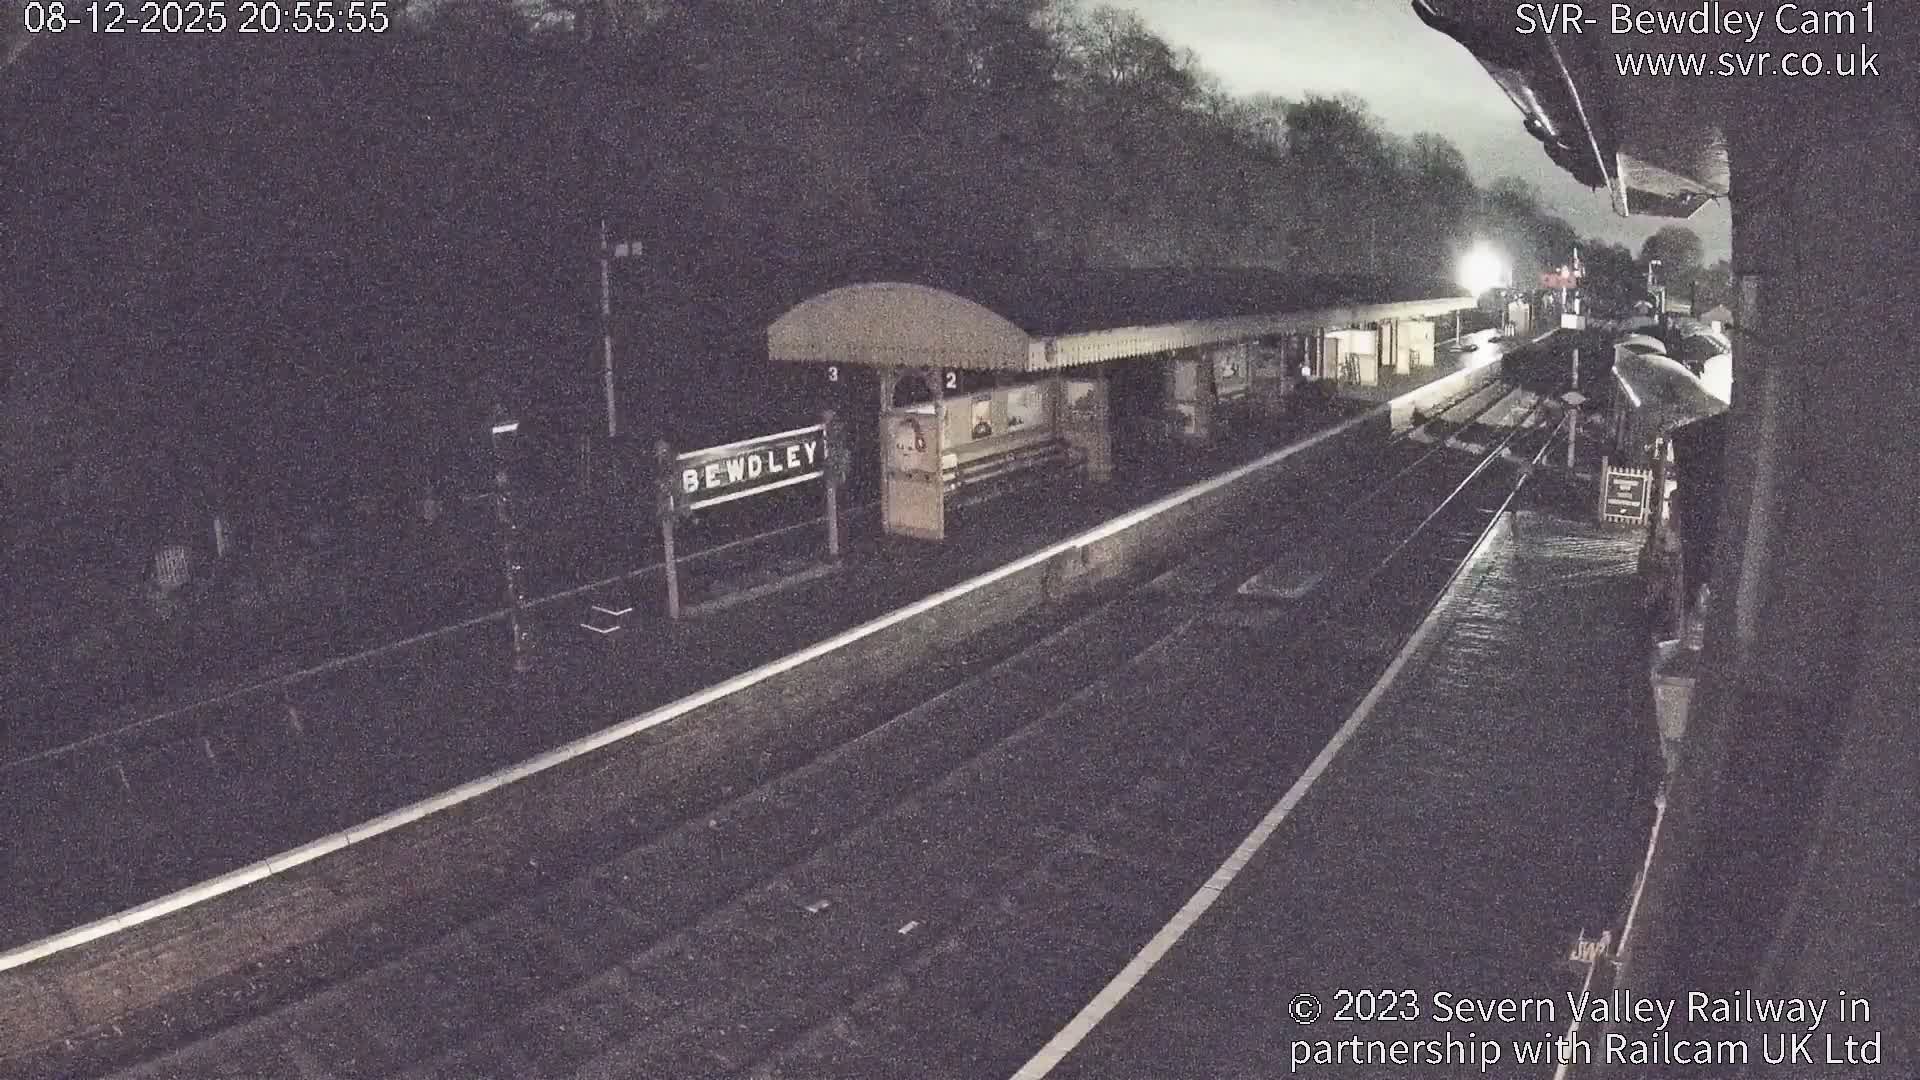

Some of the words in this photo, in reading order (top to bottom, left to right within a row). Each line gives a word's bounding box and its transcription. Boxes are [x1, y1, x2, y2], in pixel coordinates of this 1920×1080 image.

[828, 366, 838, 382] 3
[945, 372, 957, 389] 2
[682, 440, 818, 494] BEWDLEY
